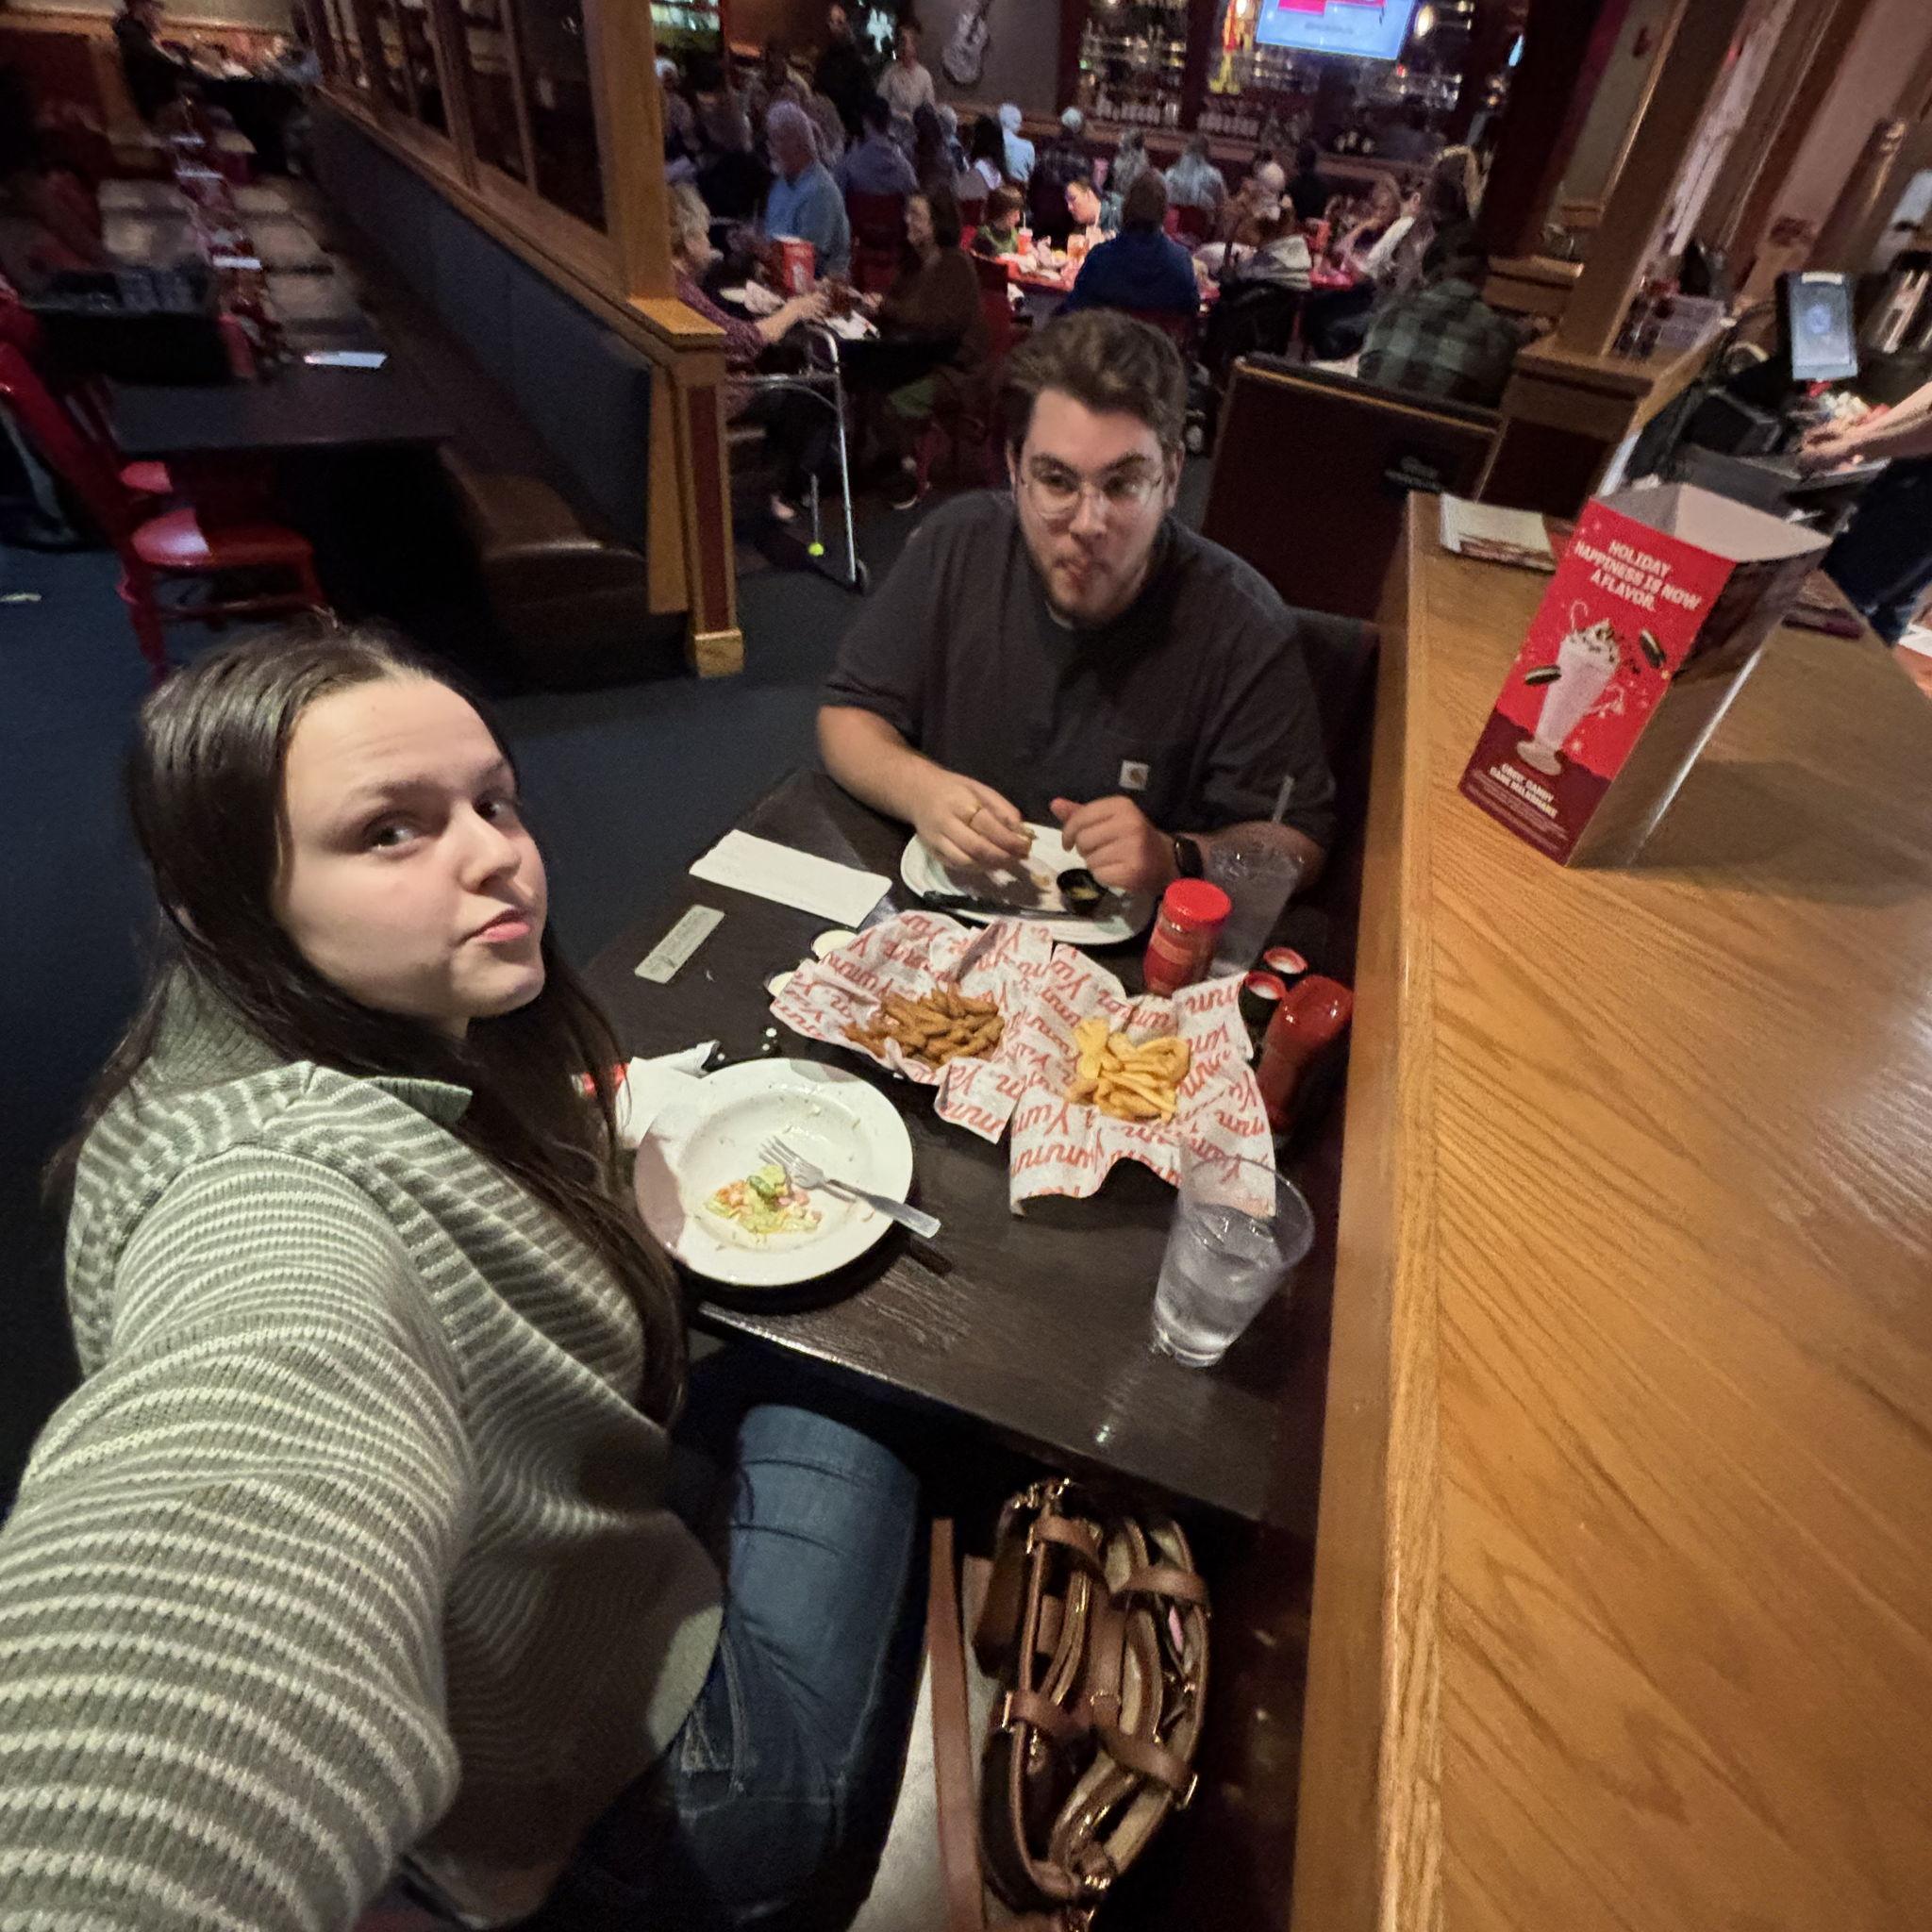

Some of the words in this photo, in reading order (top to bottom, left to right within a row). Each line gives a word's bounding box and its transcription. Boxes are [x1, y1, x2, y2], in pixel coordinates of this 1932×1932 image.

[1574, 540, 1645, 587] HAPPINESS
[1642, 575, 1663, 594] IS
[1660, 583, 1702, 611] NOW
[1590, 568, 1602, 585] A
[1607, 539, 1672, 578] HOLIDAY
